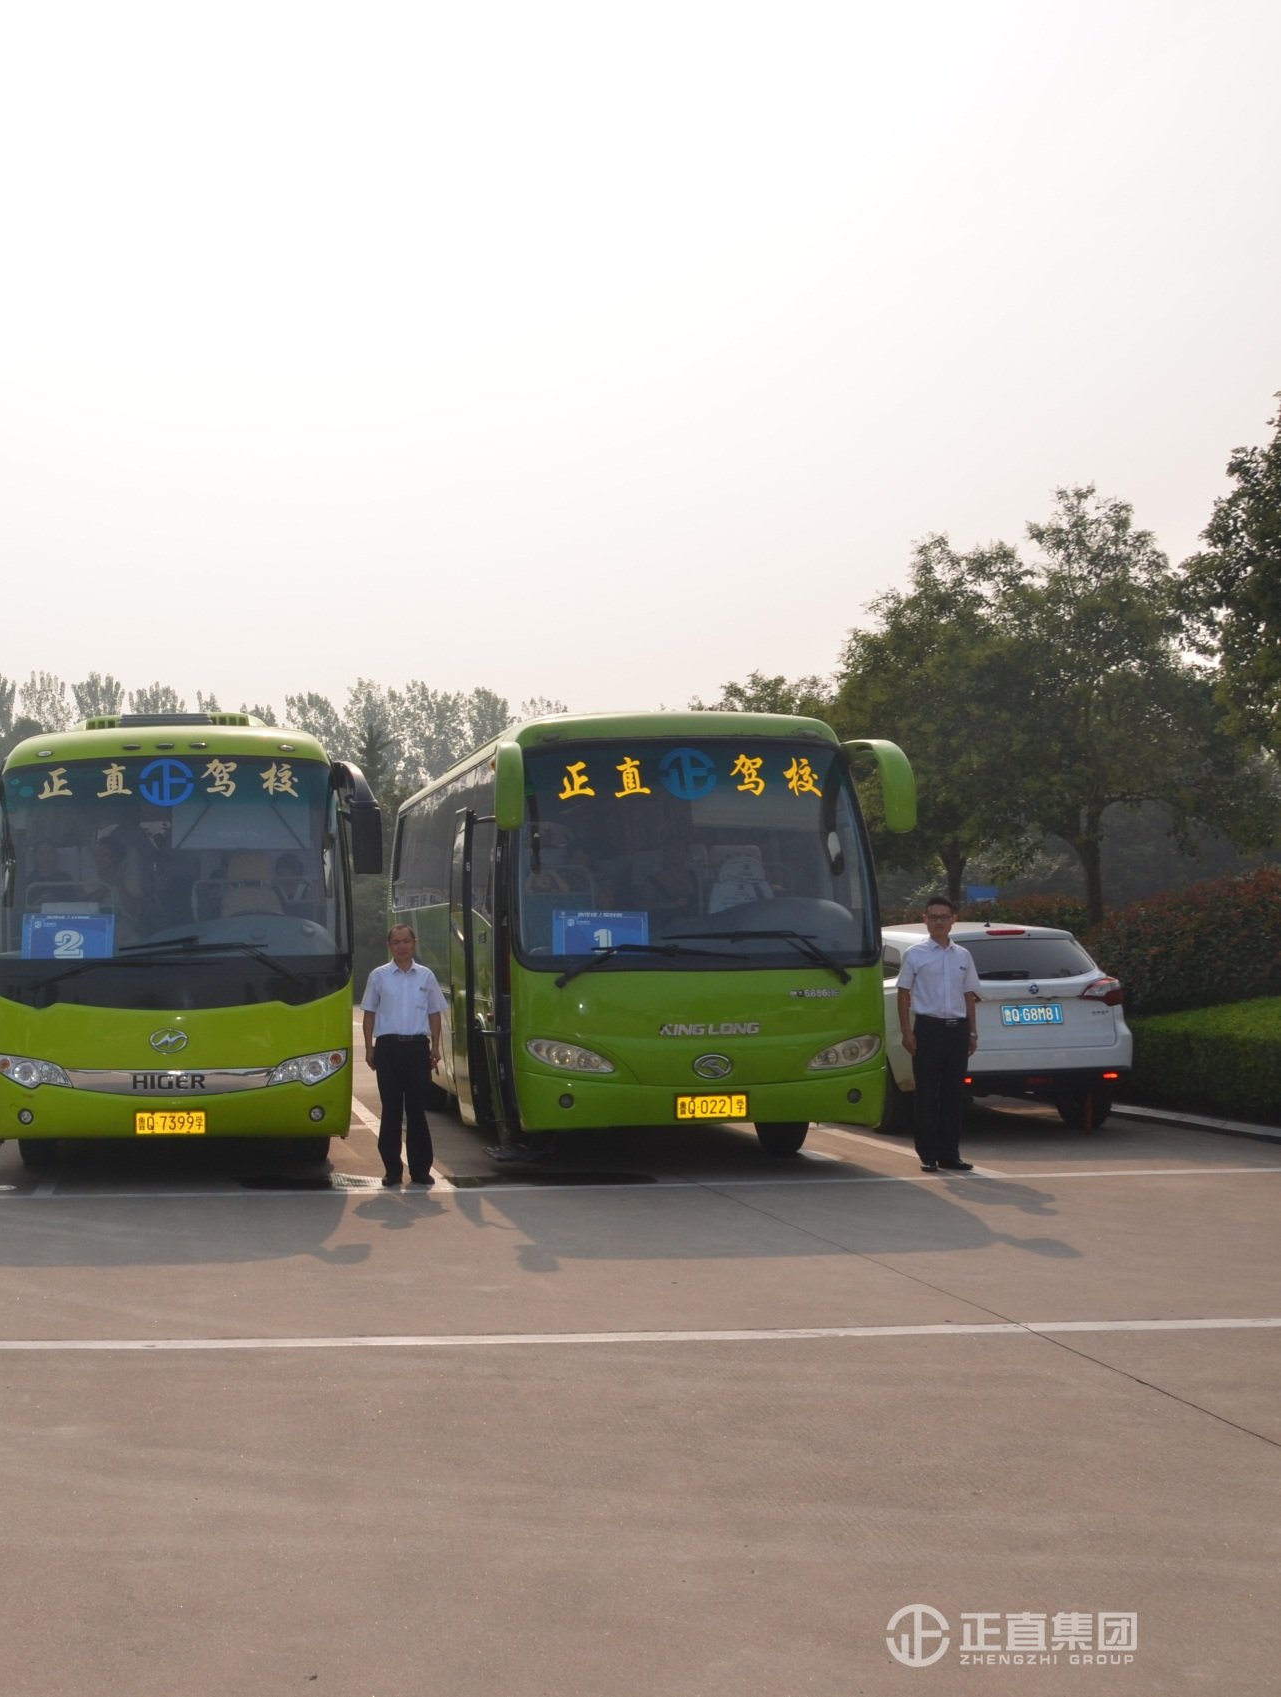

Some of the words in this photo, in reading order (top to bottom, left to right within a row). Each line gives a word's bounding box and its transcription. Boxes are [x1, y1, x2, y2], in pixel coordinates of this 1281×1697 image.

[38, 763, 133, 799] 正直
[200, 759, 300, 798] 驾校
[558, 756, 651, 800] 正直
[729, 753, 824, 798] 驾校
[54, 930, 84, 959] 2
[593, 928, 615, 954] 1
[660, 1024, 706, 1035] KING
[708, 1022, 760, 1035] LONG
[132, 1074, 206, 1089] HIGER
